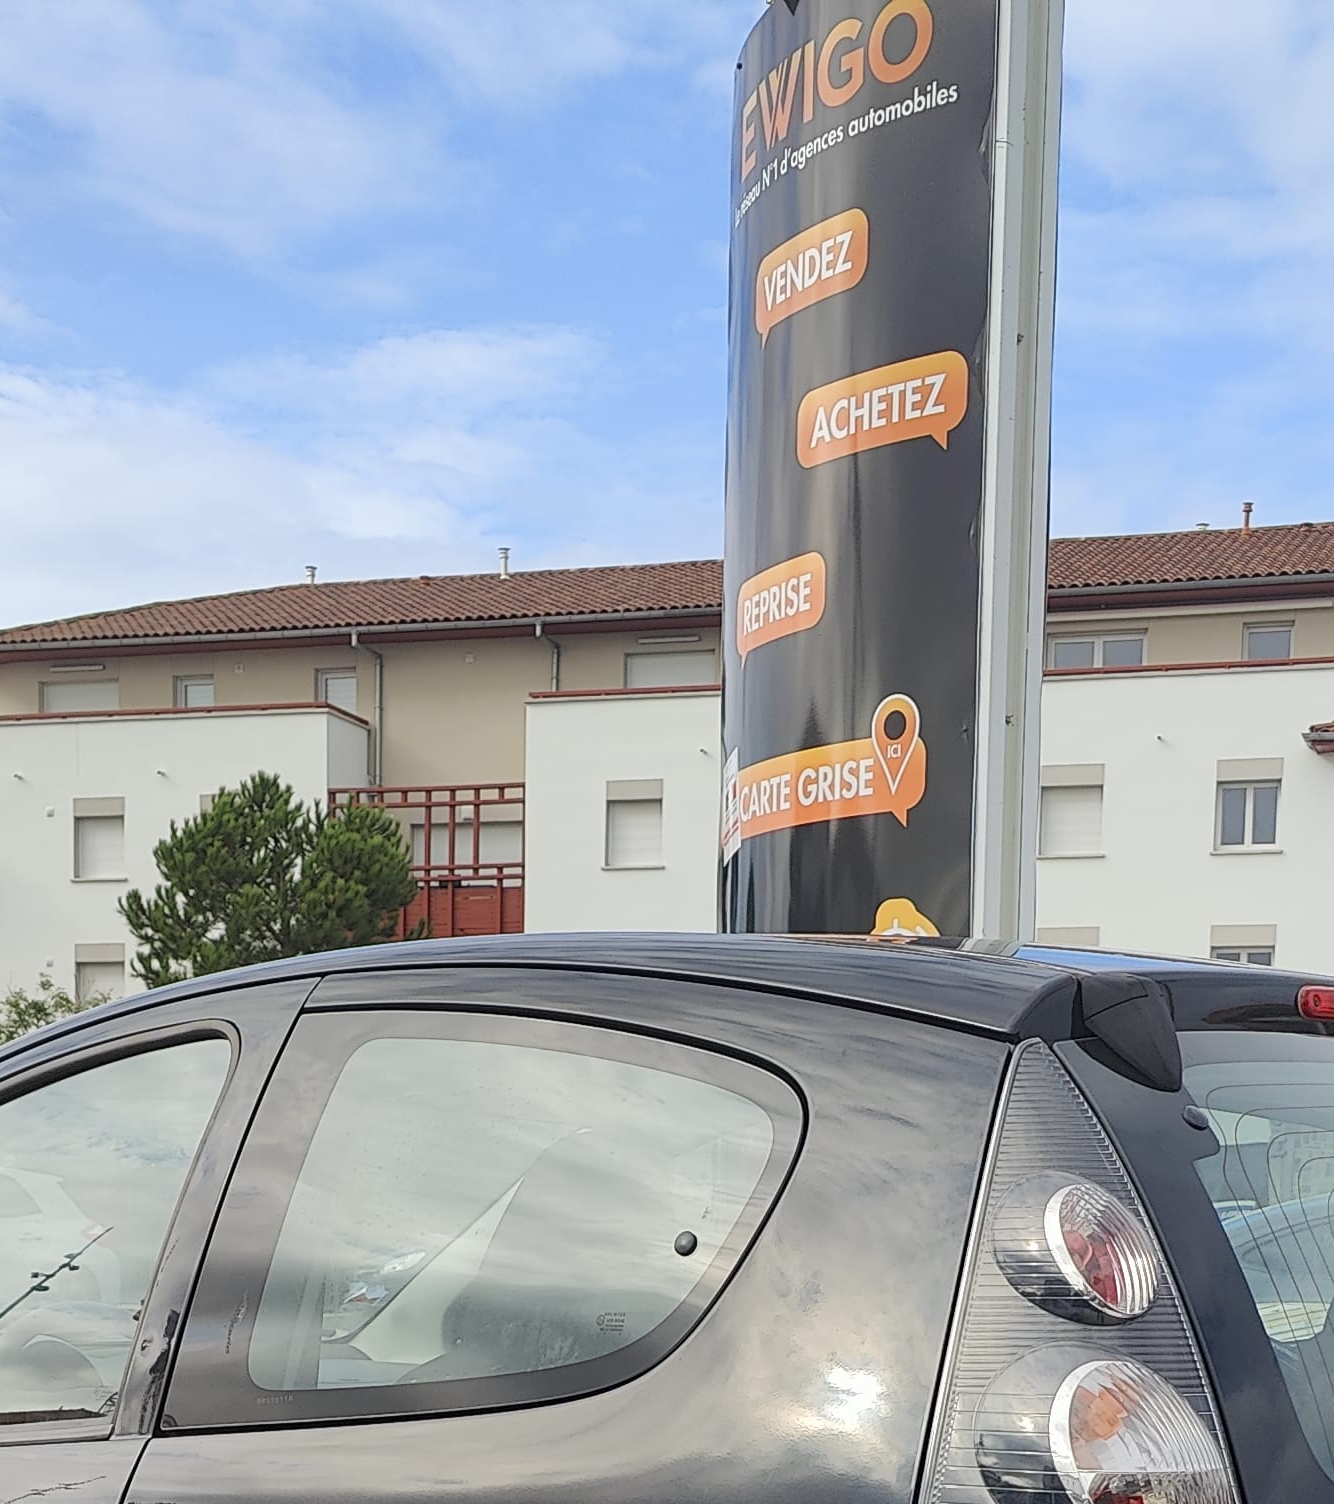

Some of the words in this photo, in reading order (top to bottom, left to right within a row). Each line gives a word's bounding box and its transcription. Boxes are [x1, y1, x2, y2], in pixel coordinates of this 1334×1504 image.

[741, 0, 933, 183] EWIGO
[848, 80, 958, 137] automobiles
[763, 230, 853, 312] VENDEZ
[810, 372, 947, 449] ACHETEZ
[743, 573, 812, 636] REPRISE
[887, 743, 901, 759] ICI
[739, 773, 791, 823] CARTE
[797, 757, 874, 807] GRISE
